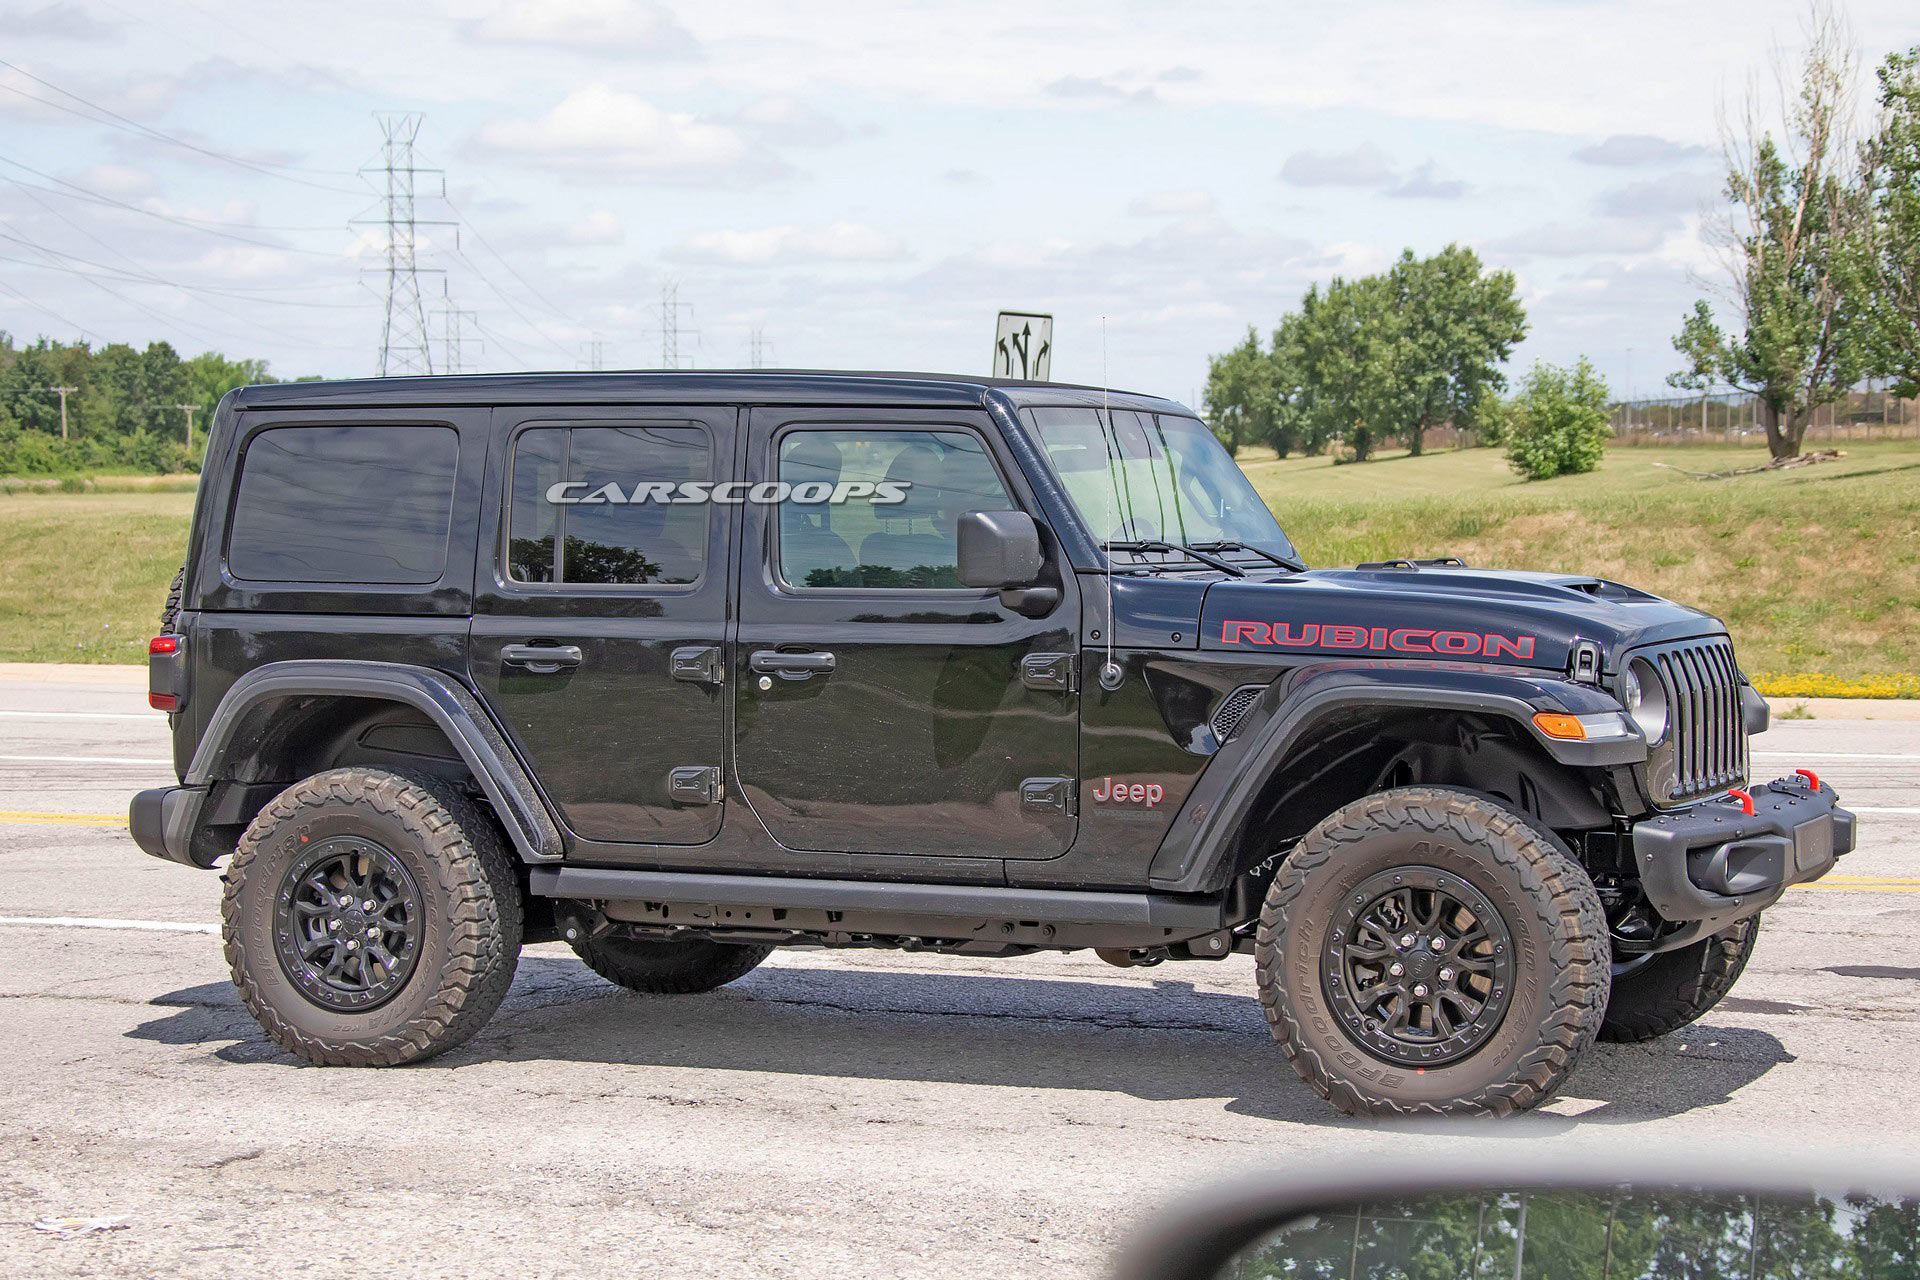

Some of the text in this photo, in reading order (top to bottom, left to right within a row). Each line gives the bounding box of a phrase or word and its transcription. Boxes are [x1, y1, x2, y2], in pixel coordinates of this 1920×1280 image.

[1222, 620, 1536, 659] RUBICON
[1092, 777, 1164, 808] Jeep
[1295, 919, 1406, 1089] BFGoodrich
